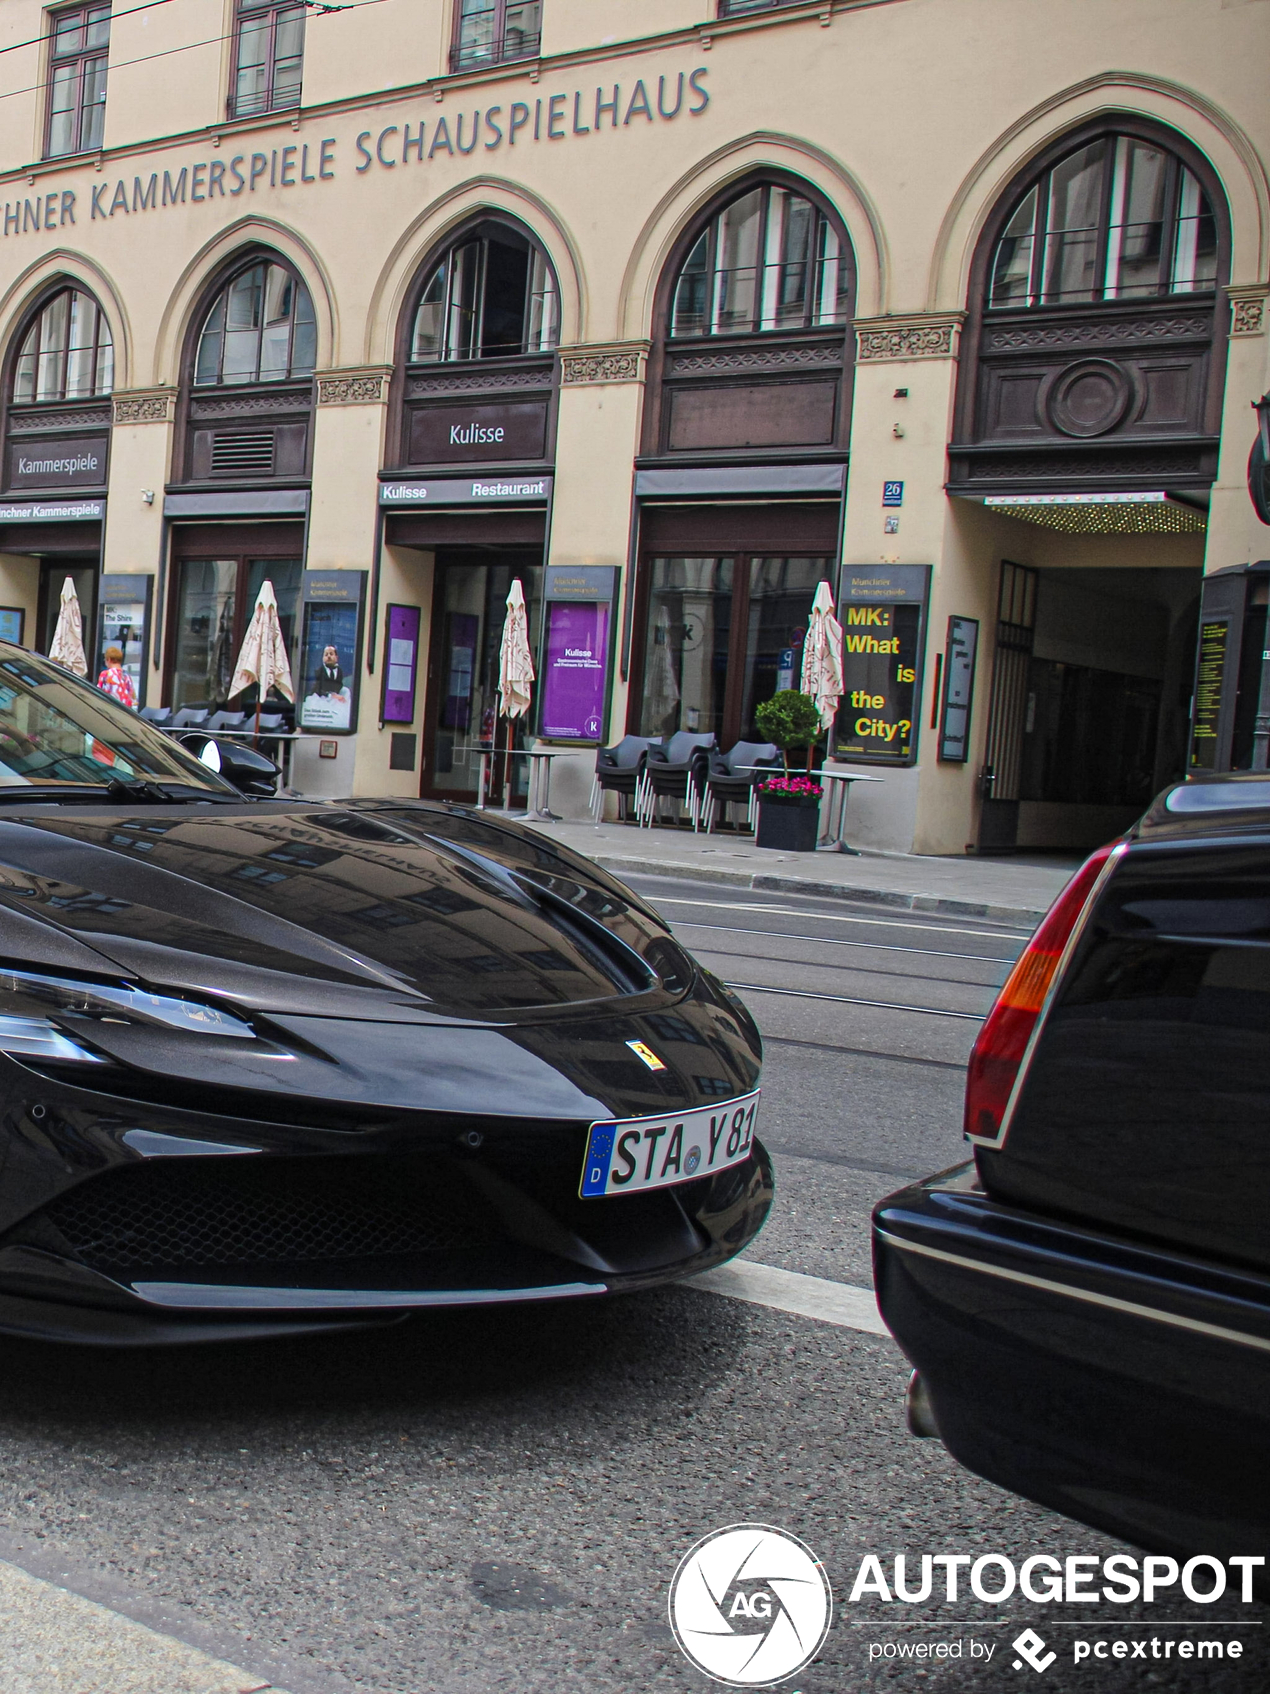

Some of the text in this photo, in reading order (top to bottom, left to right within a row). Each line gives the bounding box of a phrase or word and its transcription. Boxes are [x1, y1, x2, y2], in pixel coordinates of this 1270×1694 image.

[90, 137, 336, 220] KAMMERSPIELE
[355, 67, 710, 172] SCHAUSPIELHAUS
[449, 423, 505, 445] Kulisse
[18, 453, 98, 475] Kammerspiele
[383, 481, 545, 499] Kulisse Restaurant
[885, 483, 901, 496] 26
[32, 503, 100, 518] Kammerspiele
[847, 608, 891, 626] MK:
[564, 648, 592, 657] Kulisse
[846, 635, 900, 654] What
[896, 664, 916, 682] is
[851, 690, 885, 709] the
[855, 718, 911, 741] City?
[611, 1123, 684, 1185] STA
[590, 1168, 602, 1183] D
